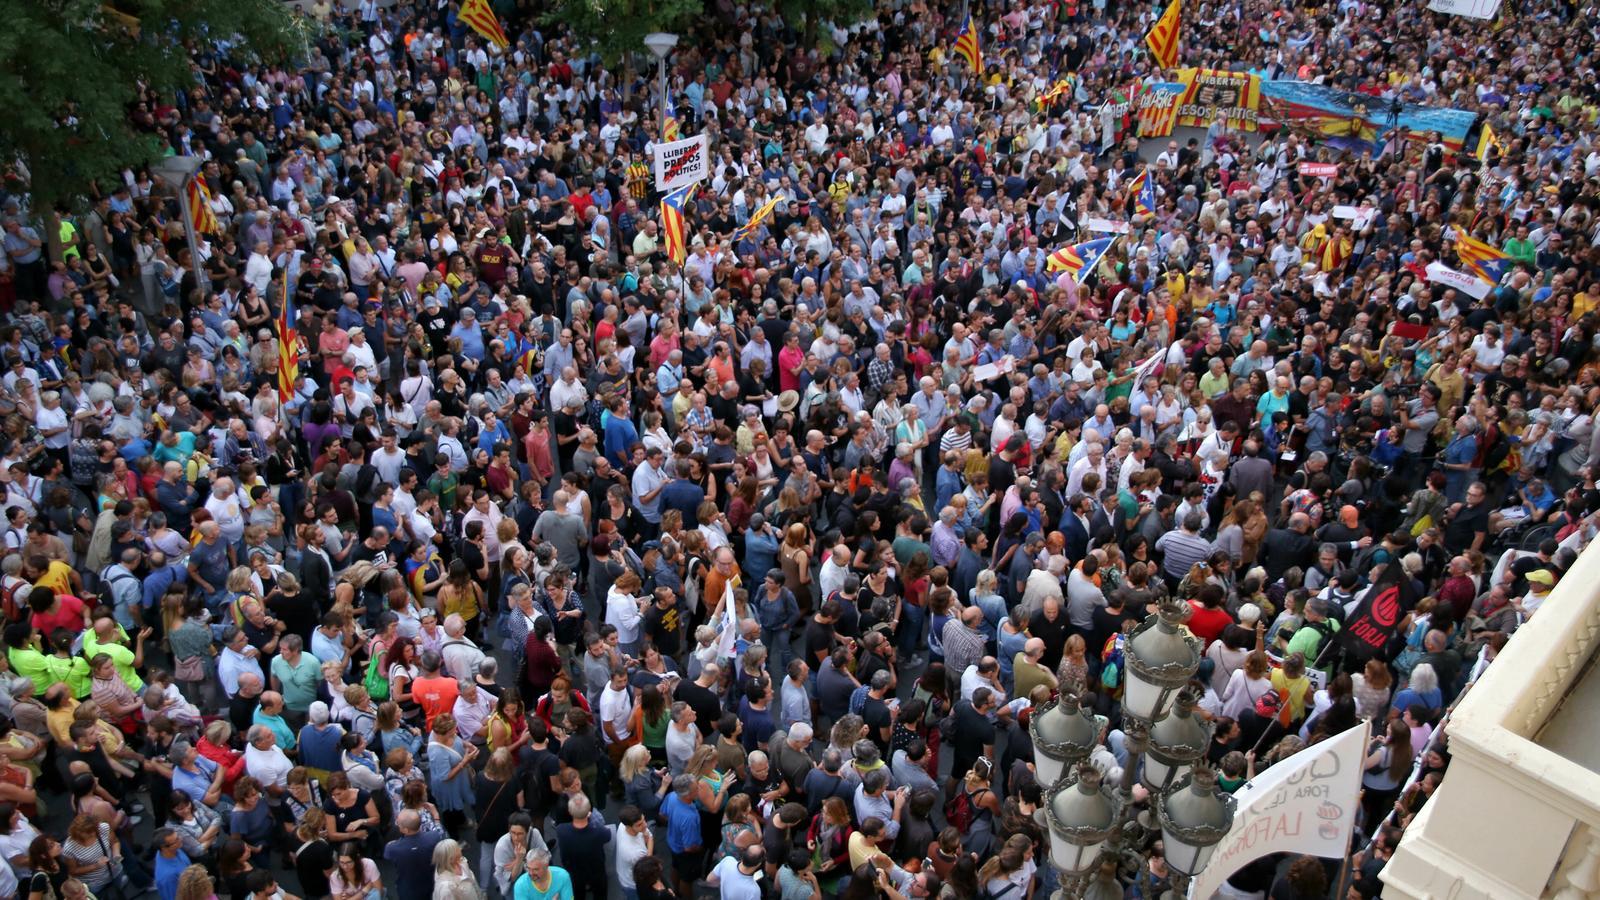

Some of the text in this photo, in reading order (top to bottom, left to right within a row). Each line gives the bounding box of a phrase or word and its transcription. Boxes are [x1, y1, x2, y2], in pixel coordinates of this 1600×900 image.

[1195, 75, 1248, 86] LLIBERTAT
[664, 142, 701, 158] LLIBERTAT
[664, 153, 701, 170] PRESOS
[1348, 619, 1388, 649] FORJA
